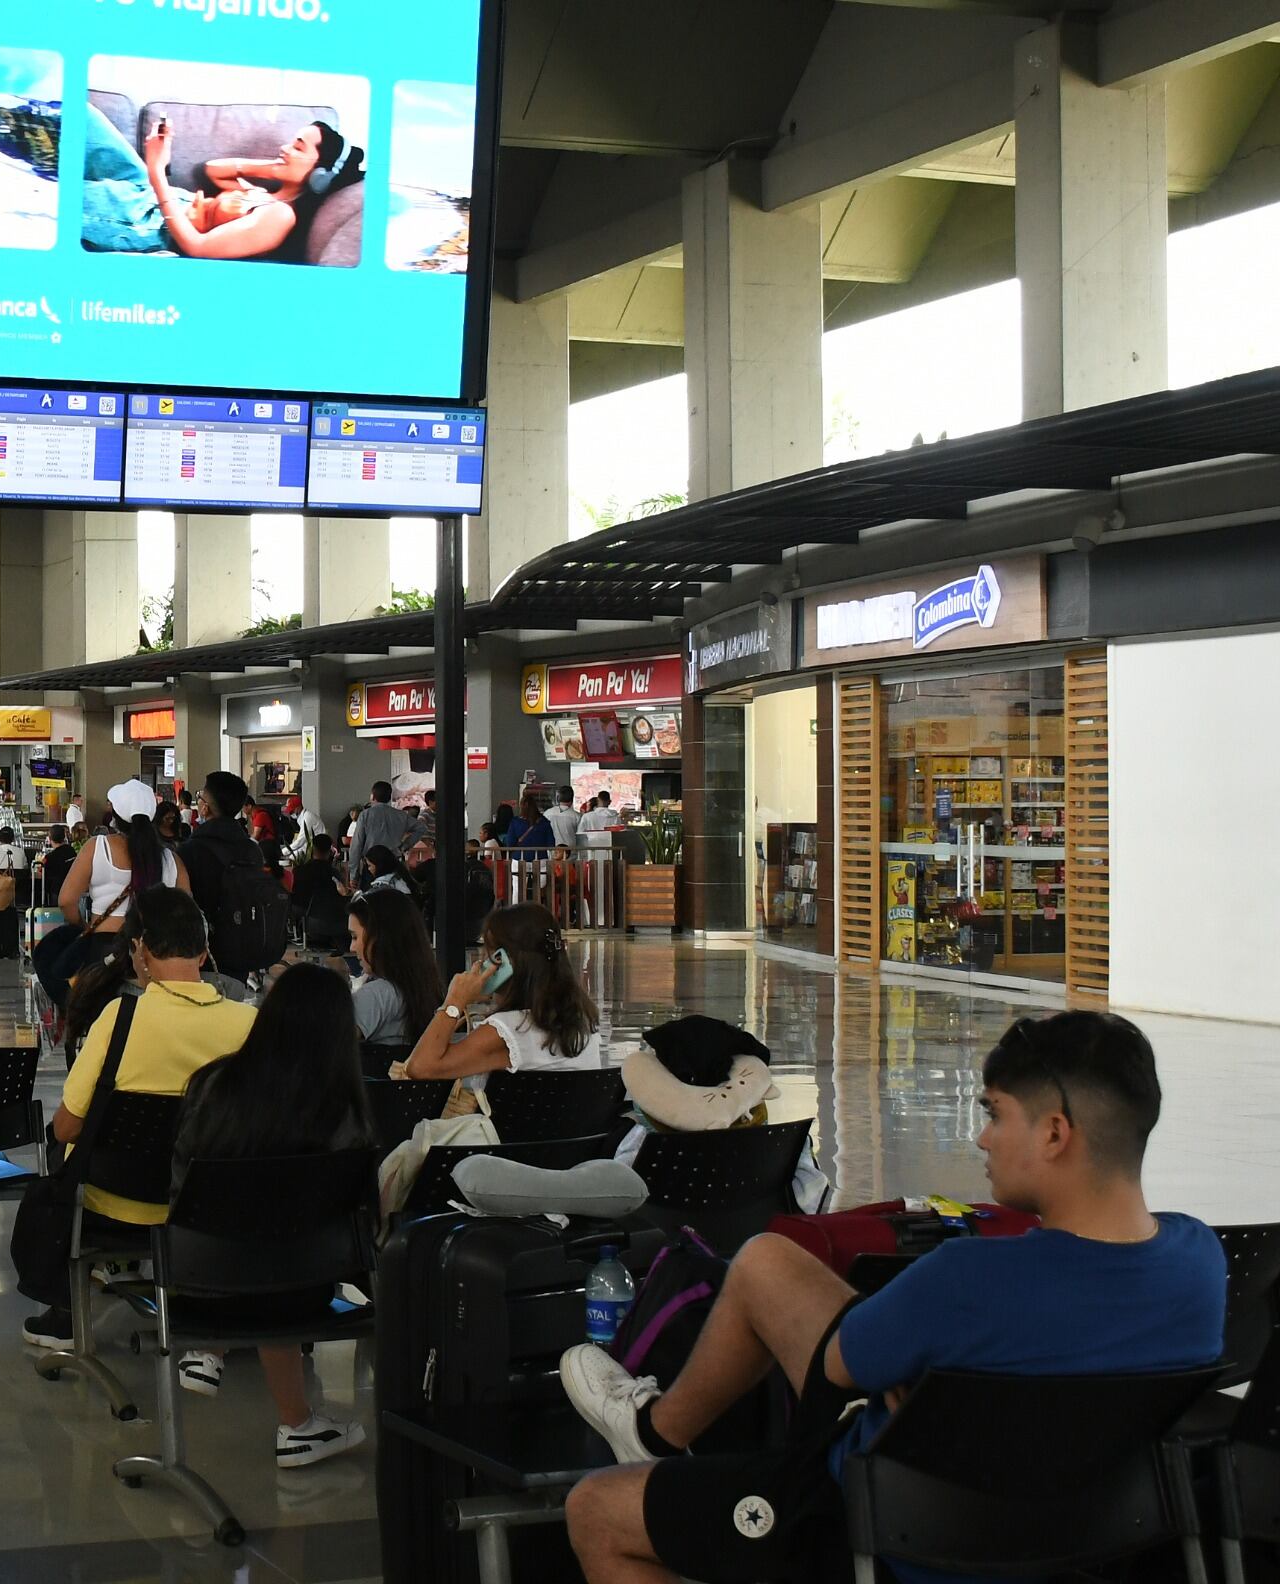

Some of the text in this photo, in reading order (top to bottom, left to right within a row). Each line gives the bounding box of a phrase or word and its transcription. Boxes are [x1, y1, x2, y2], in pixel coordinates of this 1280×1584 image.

[81, 300, 166, 325] lifemiles
[919, 588, 970, 632] Colombina
[726, 628, 770, 661] NACIONAL
[578, 666, 651, 698] Pan Pa' Ya!
[388, 690, 407, 712] Pan
[409, 688, 425, 710] Pa'
